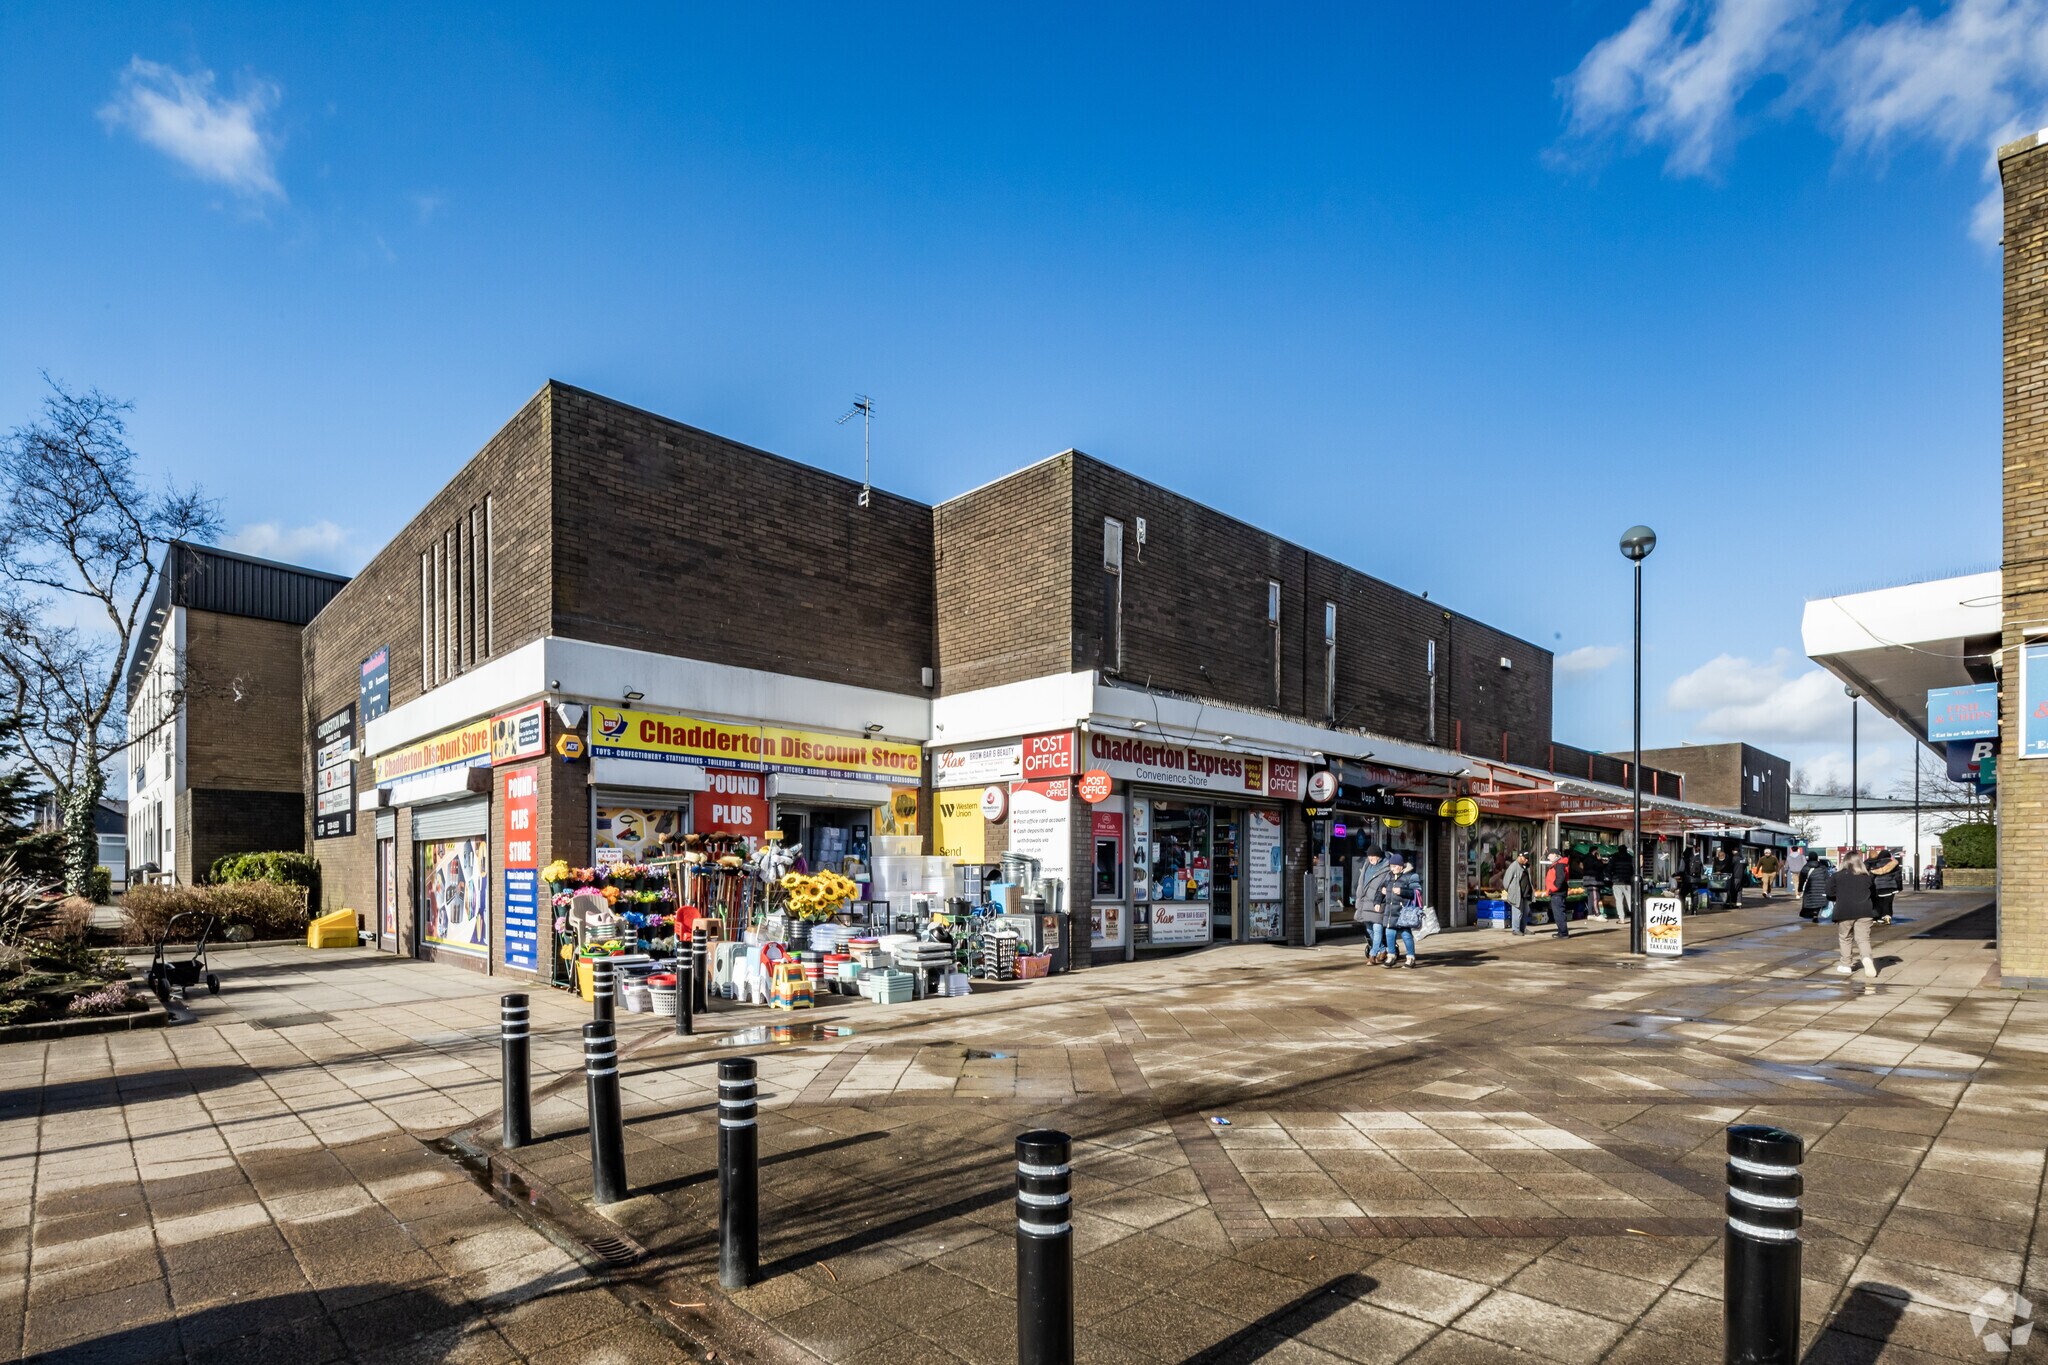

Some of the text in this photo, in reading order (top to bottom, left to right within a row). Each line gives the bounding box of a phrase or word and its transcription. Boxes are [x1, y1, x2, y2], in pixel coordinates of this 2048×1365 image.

[1947, 703, 1978, 713] FISH
[1949, 711, 1992, 722] CHIPS
[384, 750, 422, 777] Chadderton
[424, 736, 460, 764] Discount
[462, 728, 488, 756] Store
[640, 720, 918, 771] Chadderton Discount Store
[1033, 735, 1064, 753] POST
[1971, 742, 1993, 762] B
[616, 750, 662, 760] CONFECTIONERY
[666, 754, 703, 764] STATIONERIES
[708, 758, 736, 767] TOILETRIES
[740, 762, 768, 771] HOUSEHLD
[784, 766, 804, 774] KITCHEN
[938, 749, 966, 769] Rose
[970, 752, 982, 760] BROW
[983, 750, 992, 758] BAR
[997, 747, 1014, 757] BEAUTY
[1025, 752, 1069, 771] OFFICE
[1091, 733, 1242, 778] Chadderton Express
[1136, 767, 1208, 786] Convenience Store
[1274, 764, 1295, 778] POST
[508, 776, 532, 798] POUND
[706, 774, 759, 795] POUND
[1081, 785, 1108, 794] OFFICE
[1086, 776, 1105, 785] POST
[1270, 777, 1297, 793] OFFICE
[1472, 781, 1500, 797] OLDHM
[1046, 788, 1067, 797] OFFICE
[1361, 792, 1376, 805] Vape
[1384, 794, 1394, 806] CBD
[511, 808, 528, 830] PLUS
[712, 804, 753, 825] PLUS
[509, 840, 531, 862] STORE
[940, 846, 962, 857] Send
[1154, 907, 1174, 925] Rose
[1653, 902, 1675, 912] FISH
[1650, 914, 1678, 926] CHIPS
